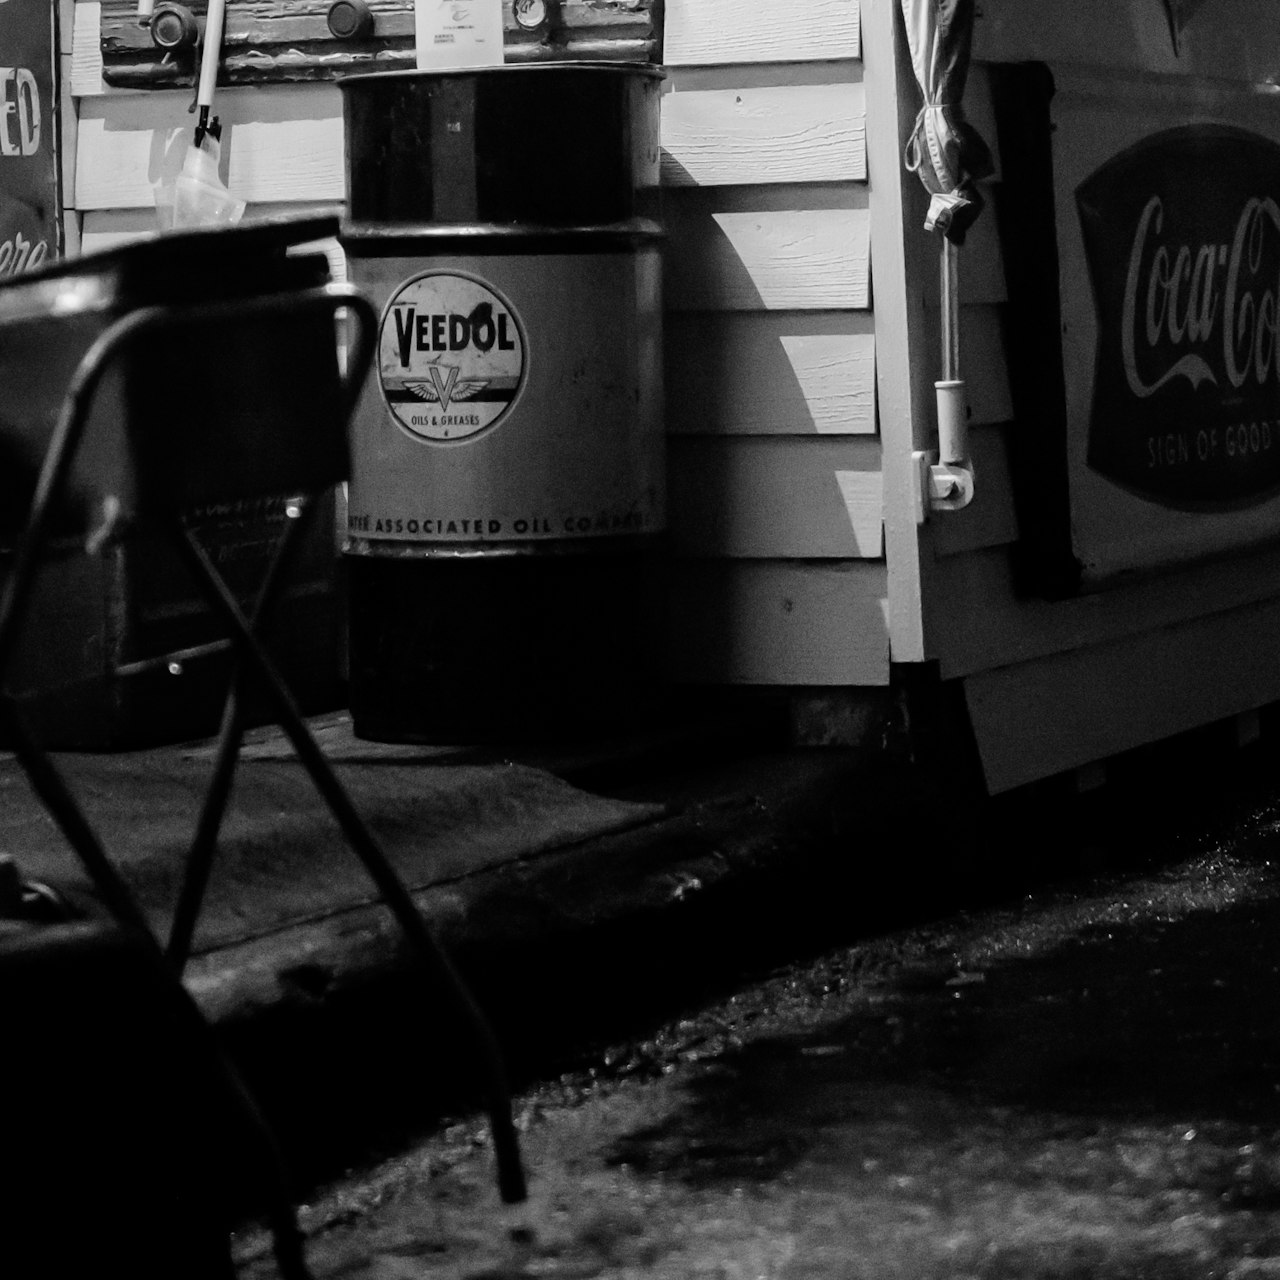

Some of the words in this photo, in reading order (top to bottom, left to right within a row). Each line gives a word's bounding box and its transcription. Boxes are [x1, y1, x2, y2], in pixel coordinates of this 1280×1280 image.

[395, 303, 515, 368] VEEDOL
[411, 415, 429, 426] OILS
[441, 414, 480, 426] GREASES
[1148, 432, 1189, 469] SIGN
[1225, 421, 1271, 457] GOOD
[375, 518, 501, 535] ASSOCIATED
[513, 517, 551, 534] OIL
